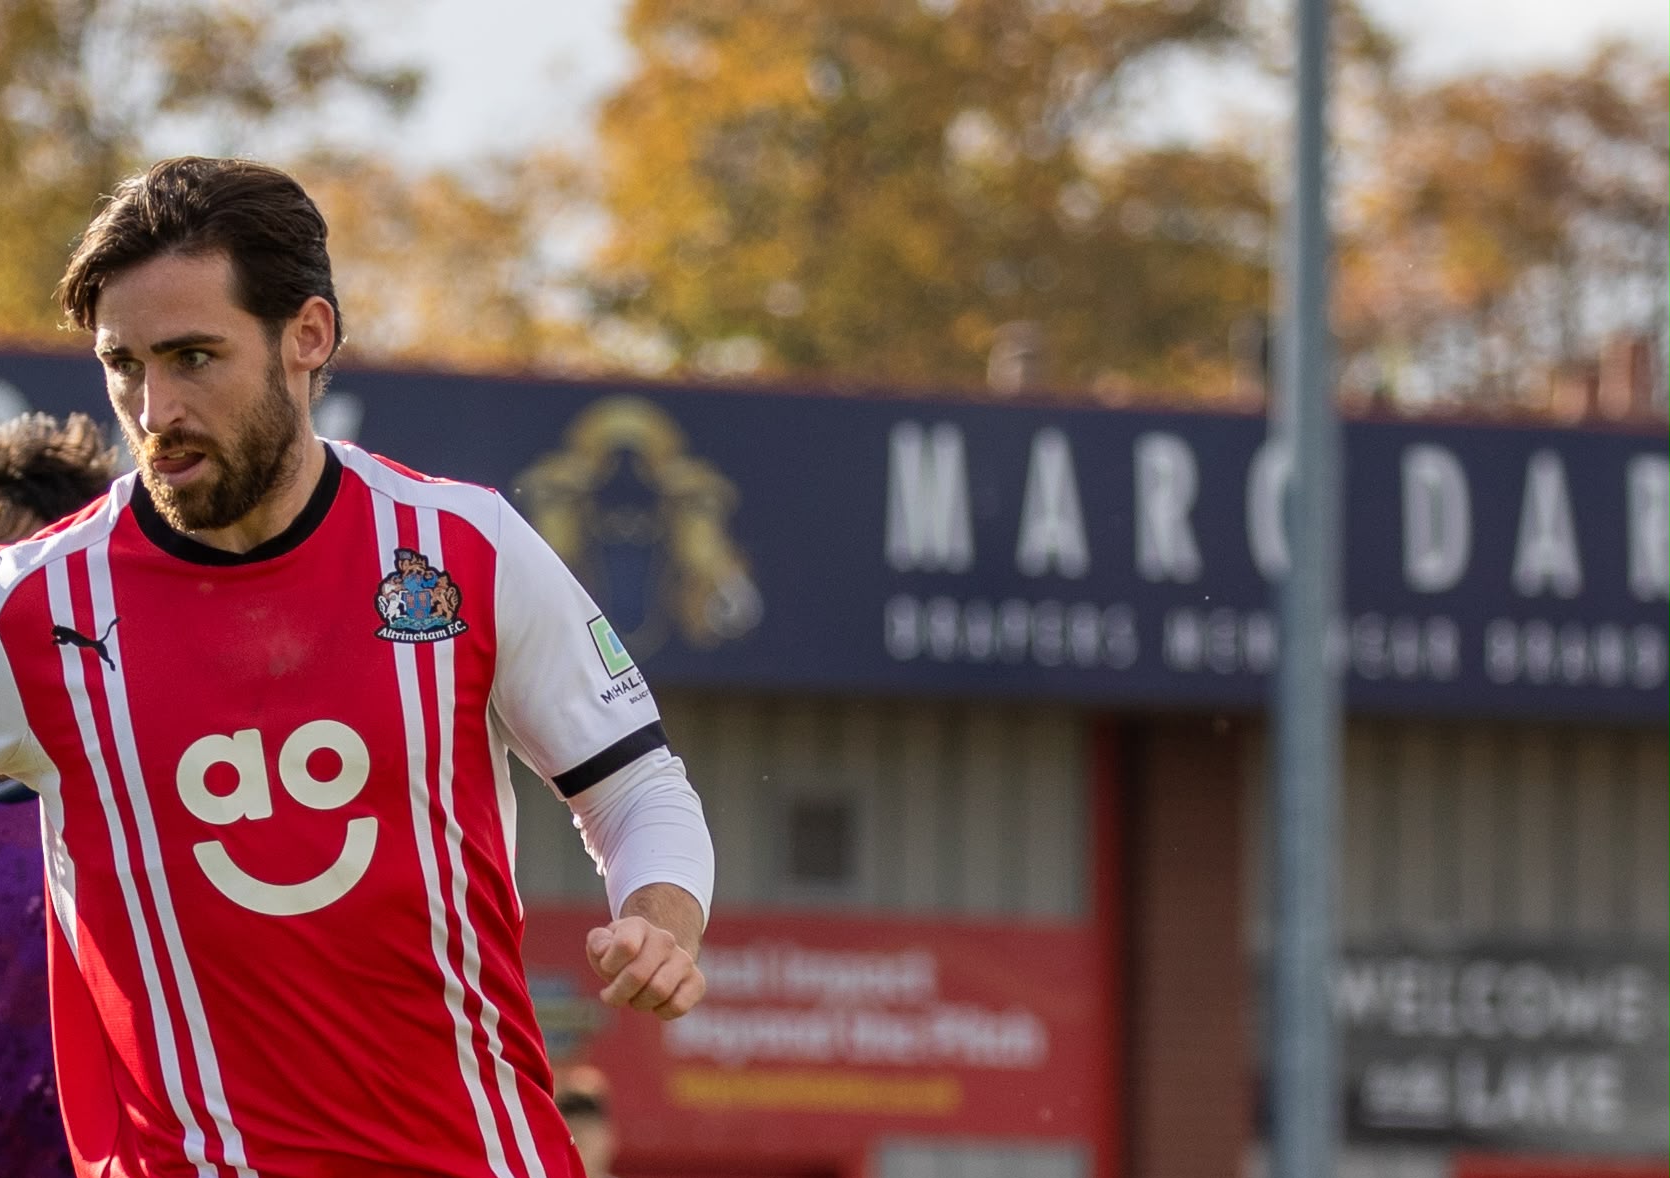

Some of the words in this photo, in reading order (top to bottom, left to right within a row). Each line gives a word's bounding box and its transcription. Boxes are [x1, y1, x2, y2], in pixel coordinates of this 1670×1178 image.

[884, 420, 1296, 583] MARC
[377, 627, 447, 642] Altrincham
[447, 619, 467, 635] F.C.
[175, 718, 371, 826] ao
[1333, 961, 1652, 1040] WELCOME
